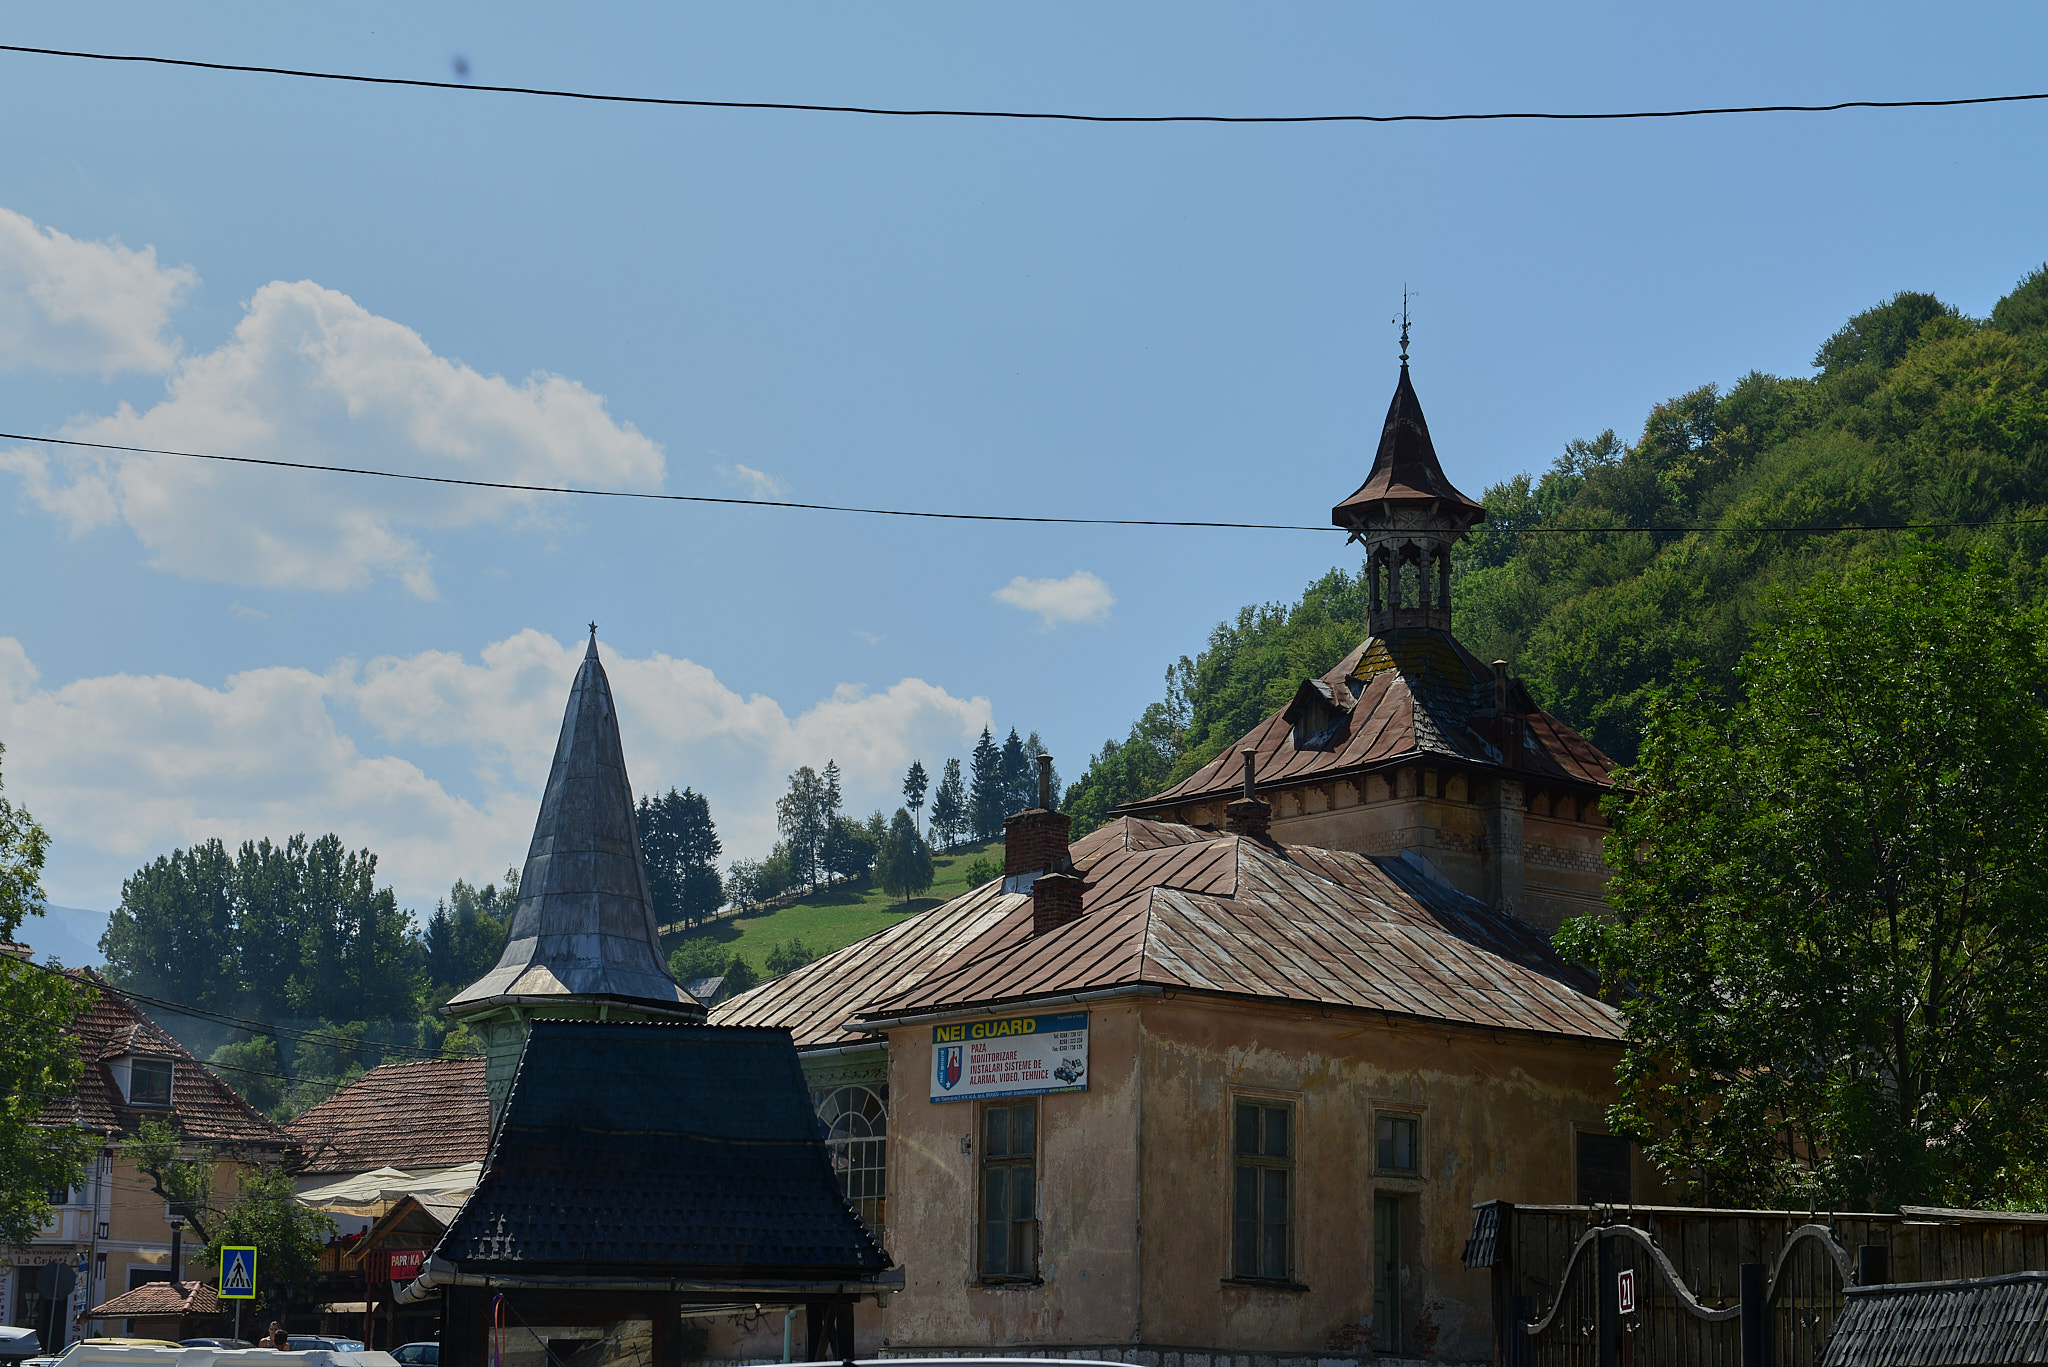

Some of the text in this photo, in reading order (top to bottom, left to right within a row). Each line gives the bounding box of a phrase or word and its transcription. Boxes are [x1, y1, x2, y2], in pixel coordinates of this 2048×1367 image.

[937, 1018, 1036, 1042] NEI GUARD
[971, 1043, 986, 1053] PAZA
[970, 1051, 1018, 1064] MONITORIZARE
[970, 1059, 1042, 1074] INSTALARI SISTEME DE
[970, 1069, 1049, 1086] ALARMA, VIDEO, TEHNICE
[17, 1255, 30, 1265] La
[1622, 1278, 1631, 1306] 21
